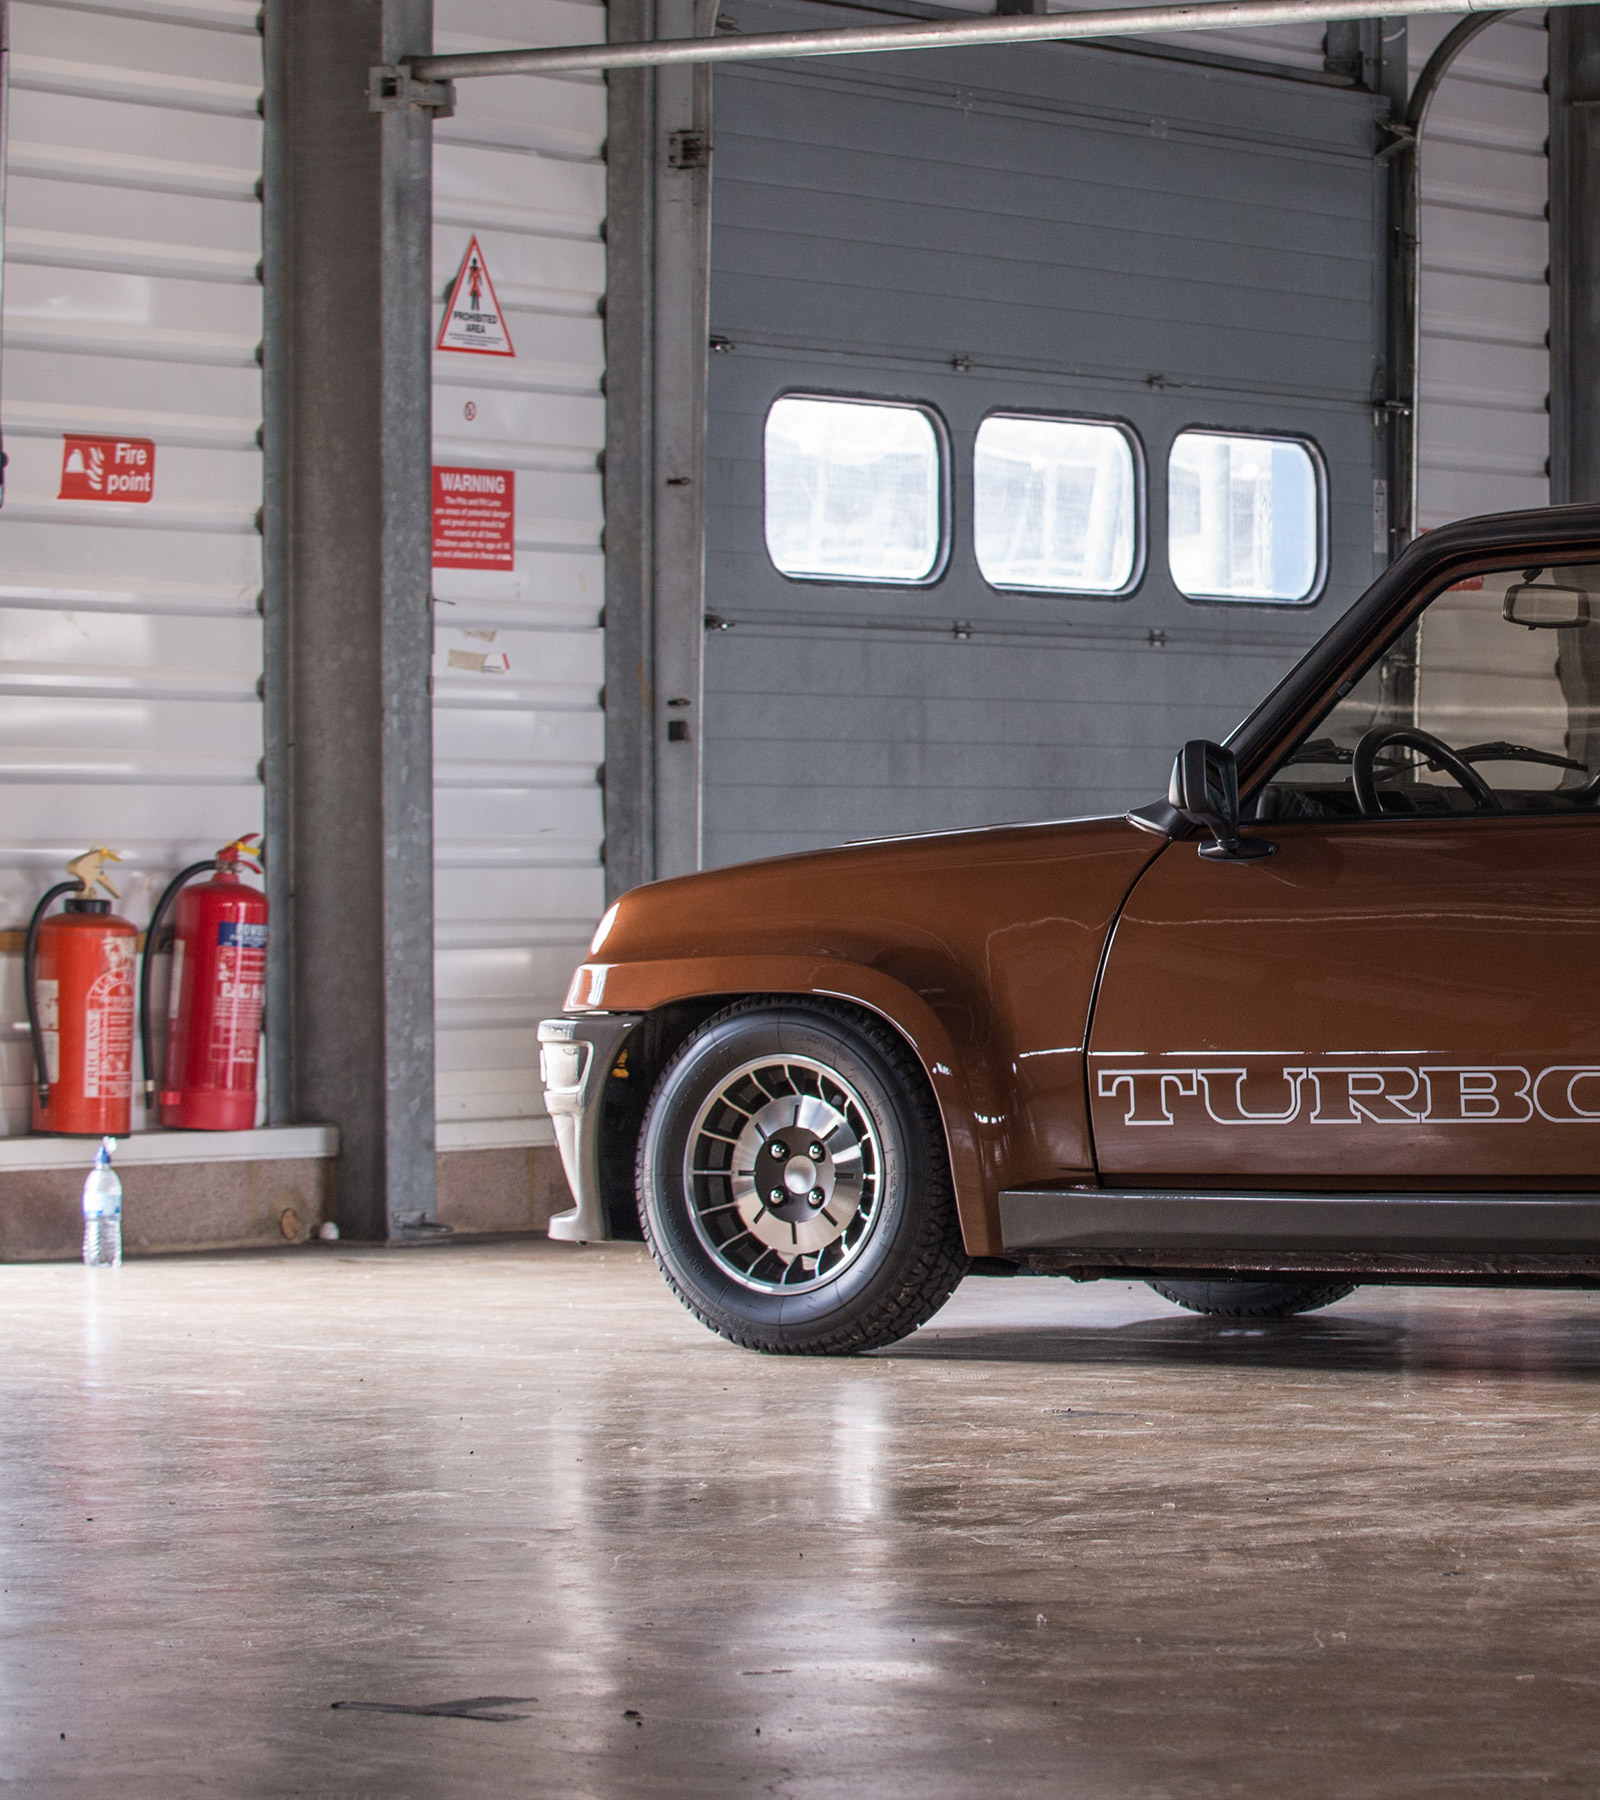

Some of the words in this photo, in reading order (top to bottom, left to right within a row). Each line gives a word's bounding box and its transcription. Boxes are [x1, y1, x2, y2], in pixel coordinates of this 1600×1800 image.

[453, 311, 498, 324] PROHIBITED
[466, 323, 486, 334] AREA
[115, 443, 147, 465] Fire
[107, 470, 151, 494] point
[441, 472, 505, 494] WARNING
